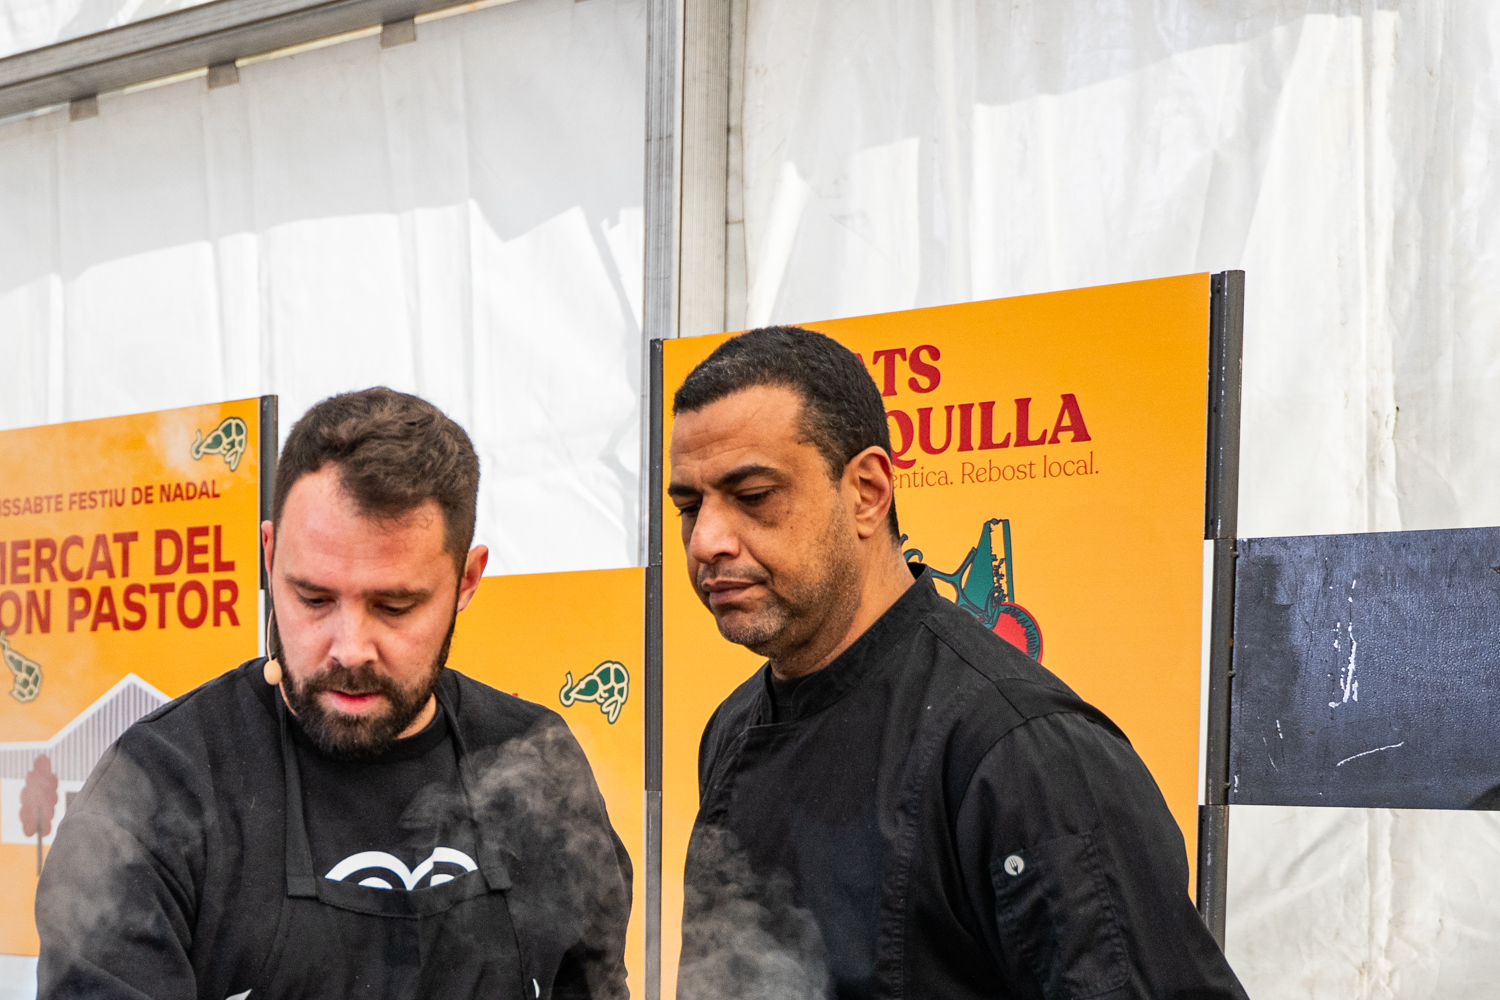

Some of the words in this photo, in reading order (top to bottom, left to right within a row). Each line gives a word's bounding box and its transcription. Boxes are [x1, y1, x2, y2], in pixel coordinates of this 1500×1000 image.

[887, 393, 1092, 469] QUILLA
[961, 459, 1037, 485] Rebost
[1043, 450, 1100, 478] local.
[68, 488, 125, 511] FESTIU
[131, 485, 154, 506] DE
[159, 479, 221, 503] NADAL
[154, 524, 236, 576] DEL
[67, 579, 241, 633] PASTOR
